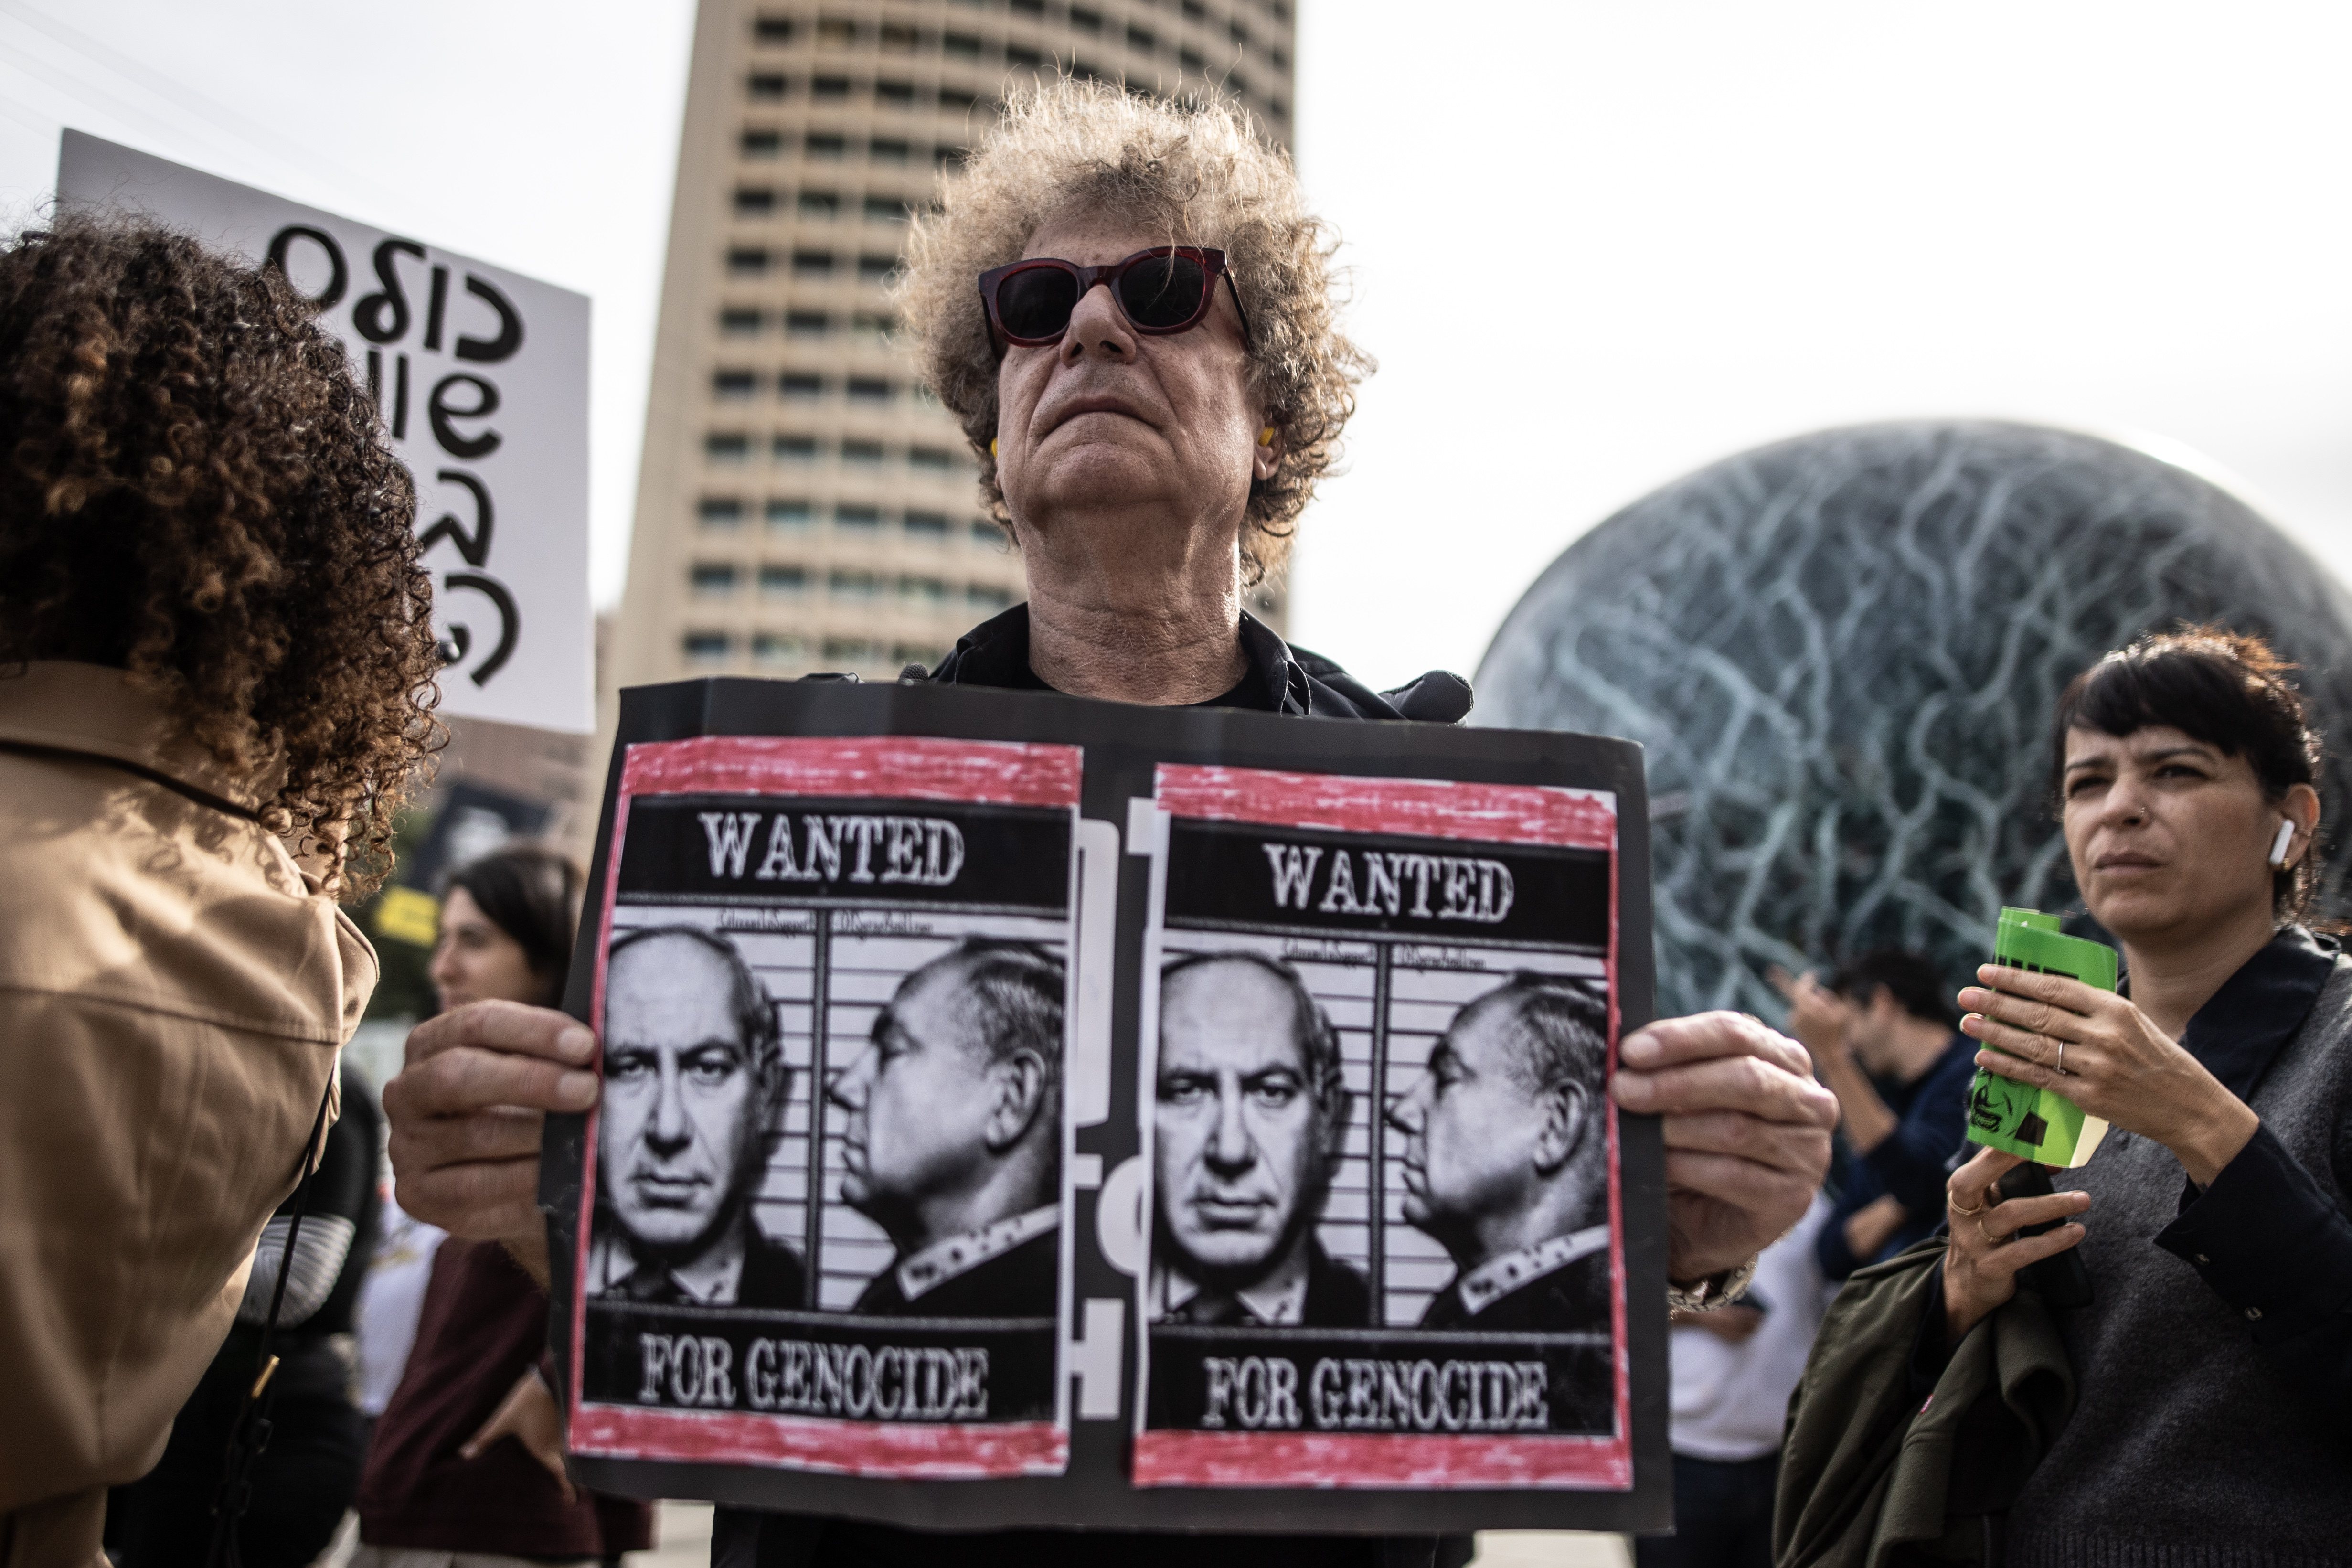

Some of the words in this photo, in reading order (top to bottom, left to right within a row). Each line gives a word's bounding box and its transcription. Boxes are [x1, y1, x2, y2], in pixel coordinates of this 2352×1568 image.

[697, 811, 965, 886] WANTED
[1261, 842, 1515, 924] WANTED
[638, 1333, 737, 1408] FOR
[745, 1337, 990, 1420] GENOCIDE
[1201, 1355, 1303, 1429] FOR
[1309, 1356, 1550, 1432] GENOCIDE
